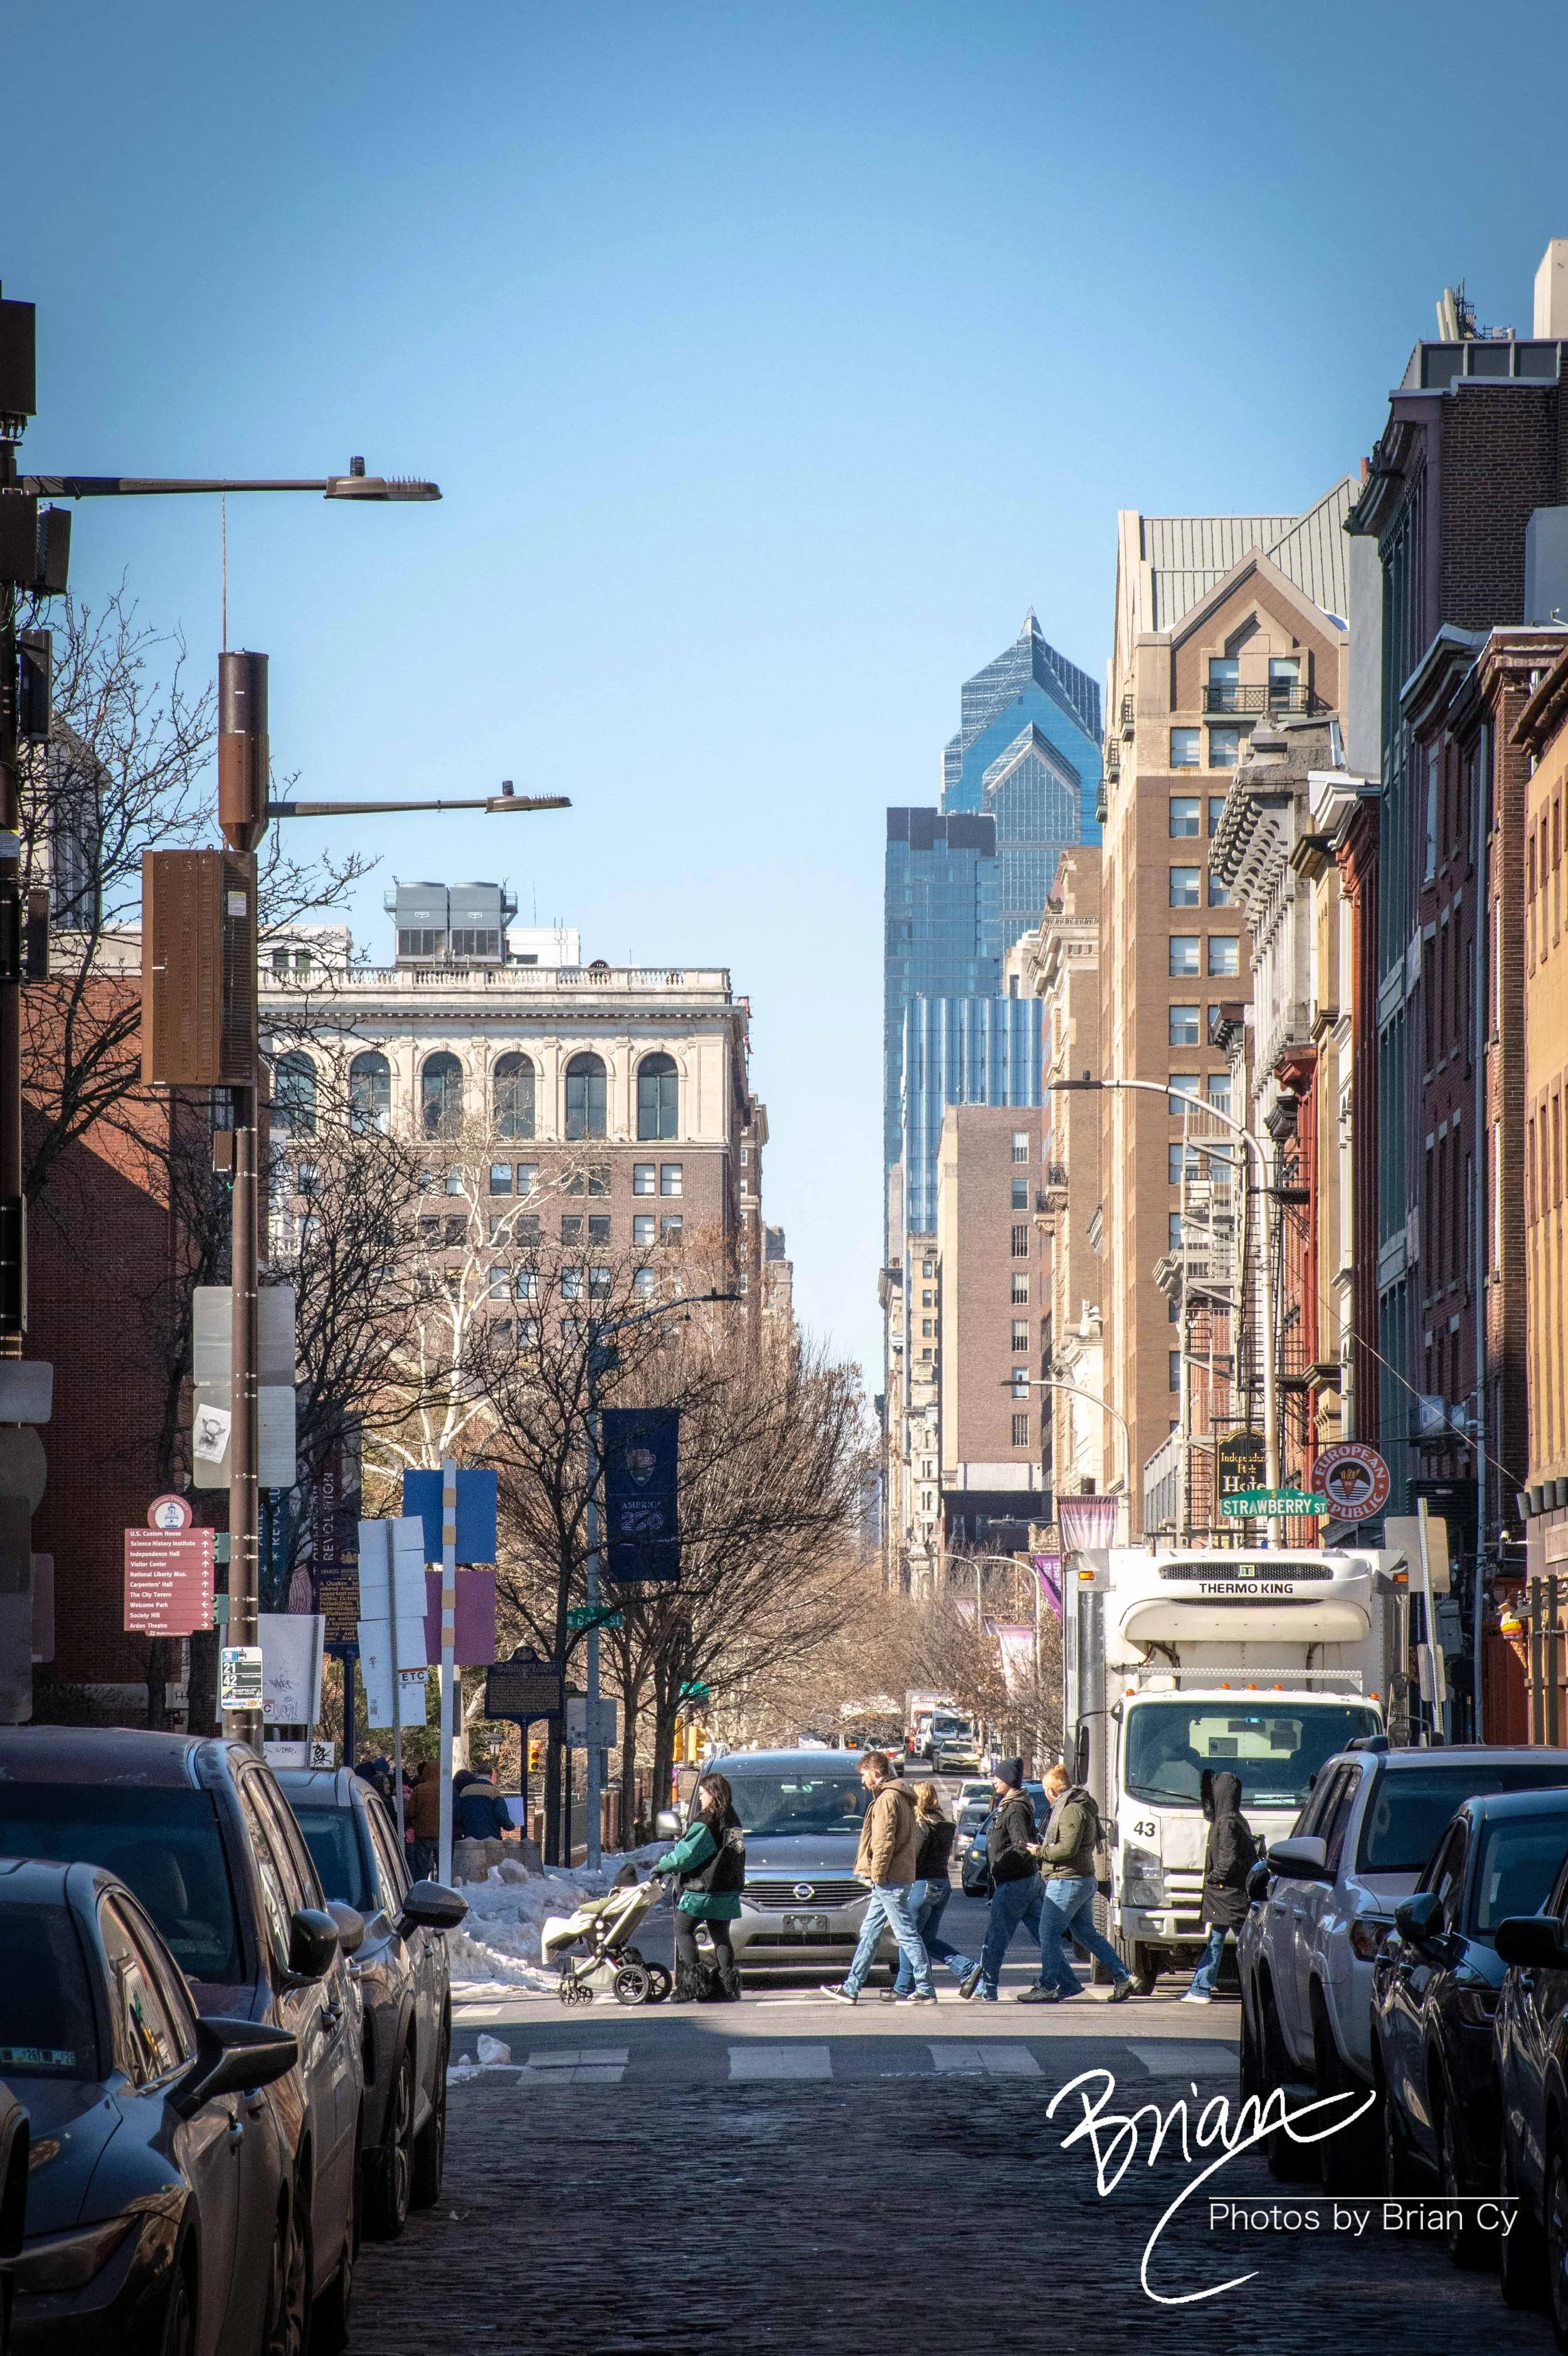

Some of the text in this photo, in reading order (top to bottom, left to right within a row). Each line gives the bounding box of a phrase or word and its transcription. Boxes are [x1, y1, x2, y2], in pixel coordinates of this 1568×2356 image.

[1314, 1445, 1386, 1478] EUROPEAN
[1222, 1475, 1266, 1492] Hote
[1271, 1490, 1276, 1499] S
[1224, 1499, 1326, 1514] STRAWBERRY ST
[323, 1473, 334, 1561] REVOLTION
[1199, 1583, 1293, 1593] THERMO KING
[223, 1662, 236, 1674] 21
[223, 1675, 237, 1686] 42
[402, 1672, 425, 1681] ETC
[1133, 1821, 1156, 1838] 43
